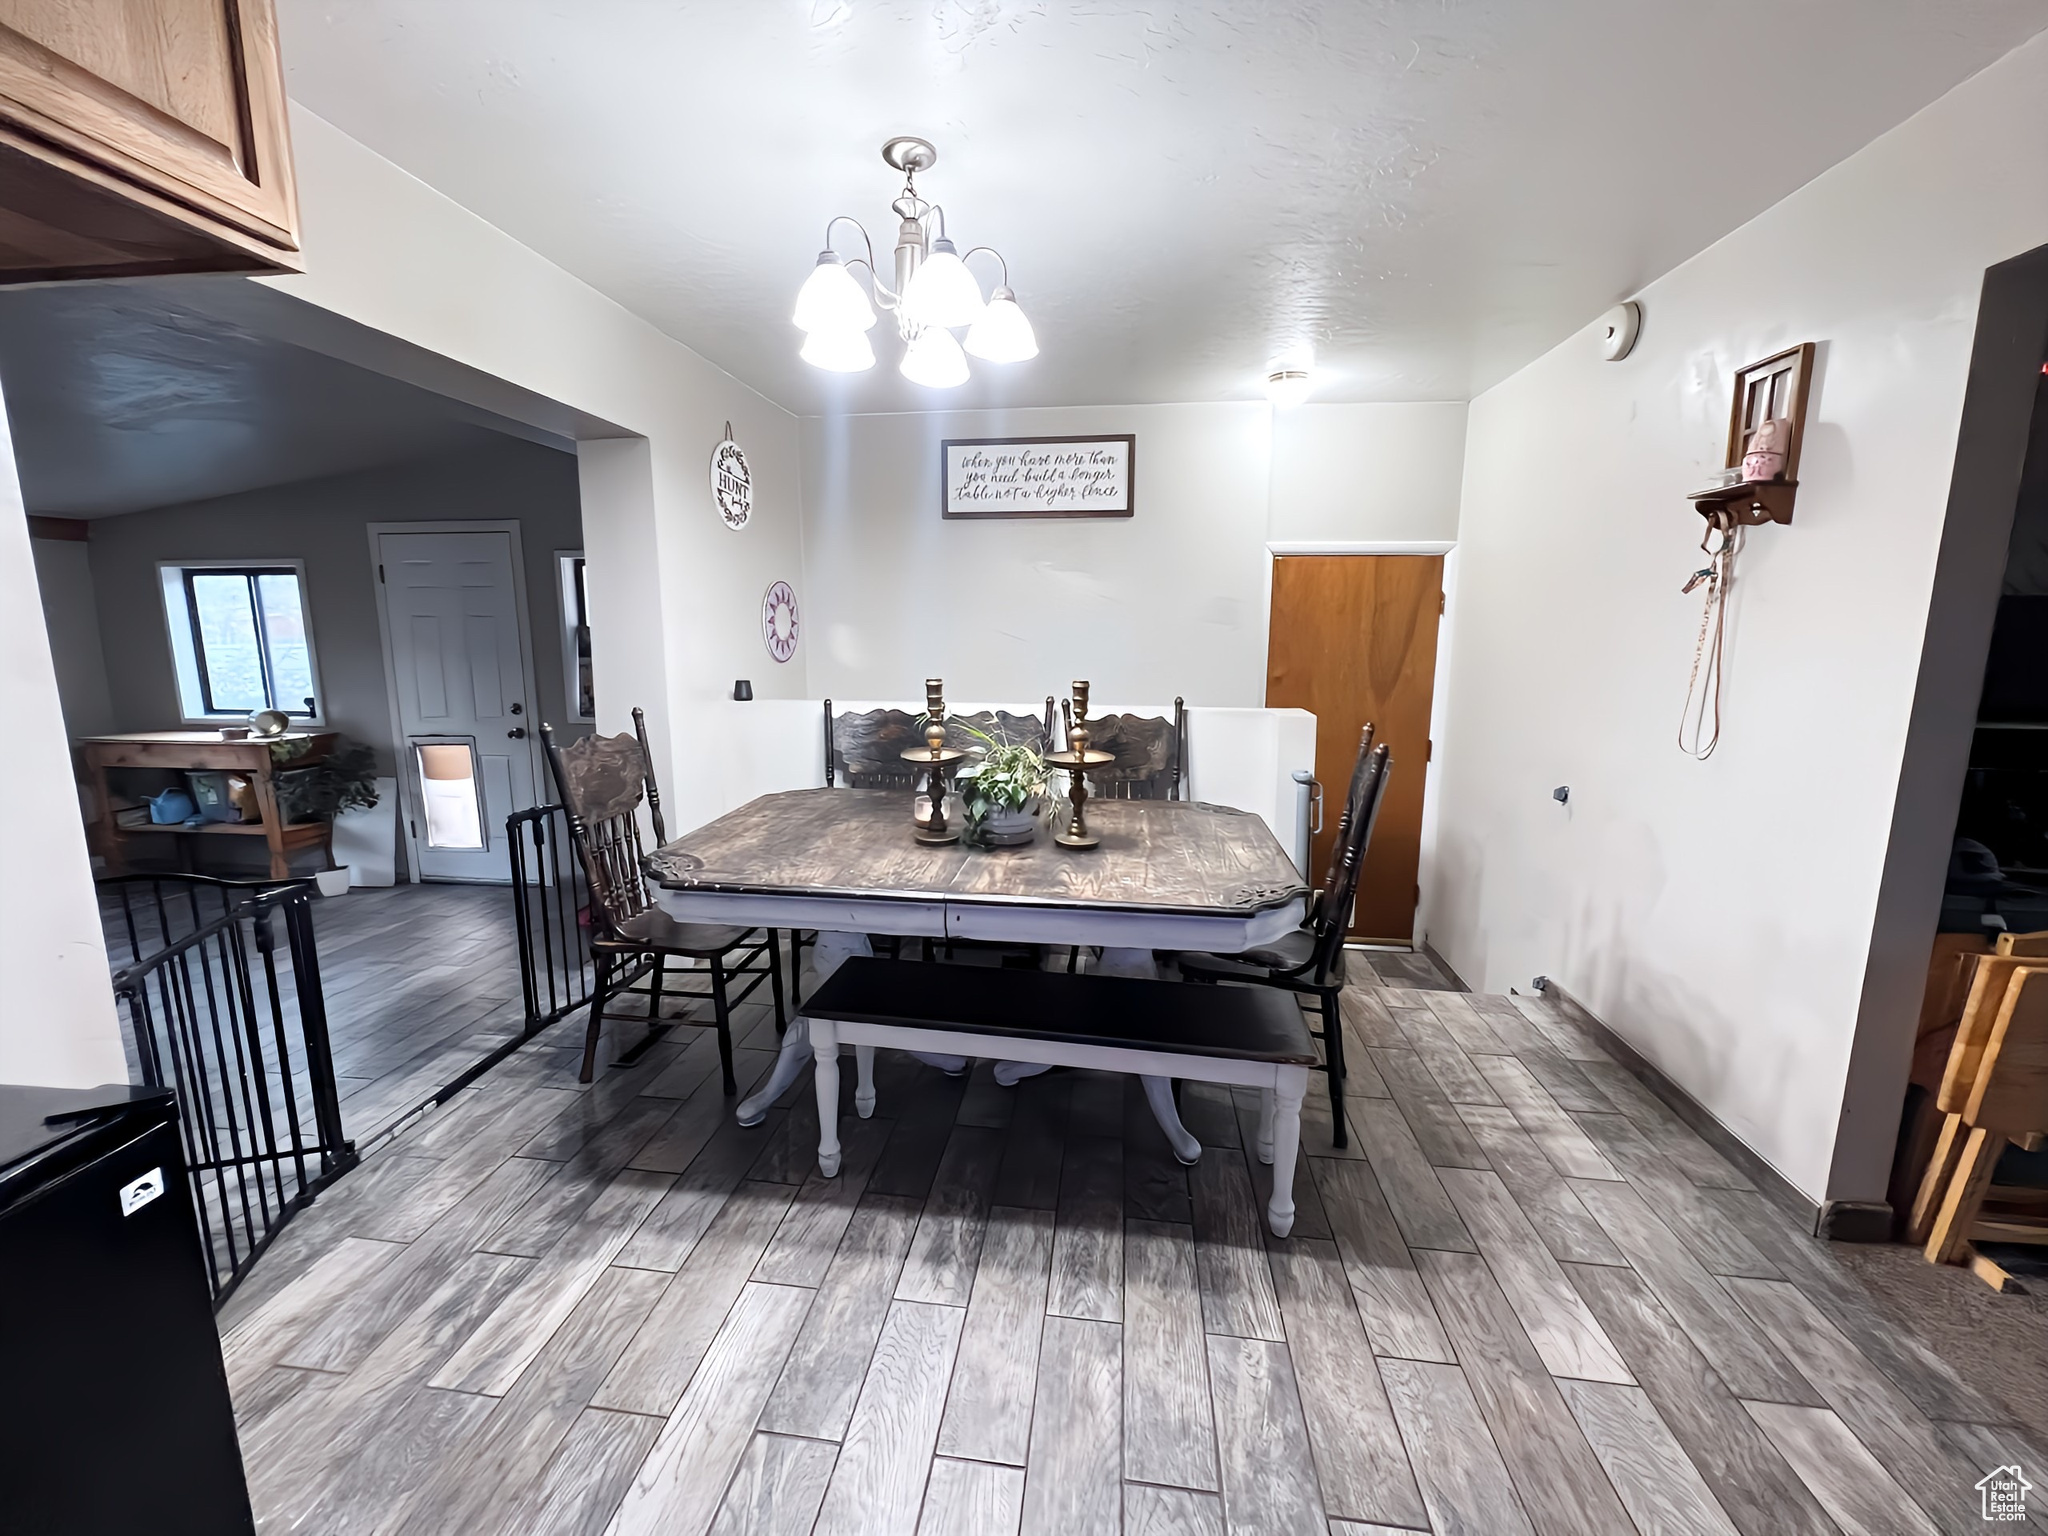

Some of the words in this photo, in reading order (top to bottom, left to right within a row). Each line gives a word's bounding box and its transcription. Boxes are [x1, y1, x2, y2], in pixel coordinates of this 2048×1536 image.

[996, 455, 1014, 473] you
[1020, 450, 1050, 467] have
[1054, 453, 1084, 465] more
[1085, 450, 1118, 465] than
[718, 472, 749, 500] HUNT
[965, 472, 986, 489] you
[991, 470, 1018, 483] need
[1022, 468, 1055, 483] build
[1058, 470, 1064, 479] a
[995, 487, 1021, 500] not
[1021, 490, 1031, 498] a
[1034, 484, 1076, 506] higher
[1081, 484, 1118, 500] fence
